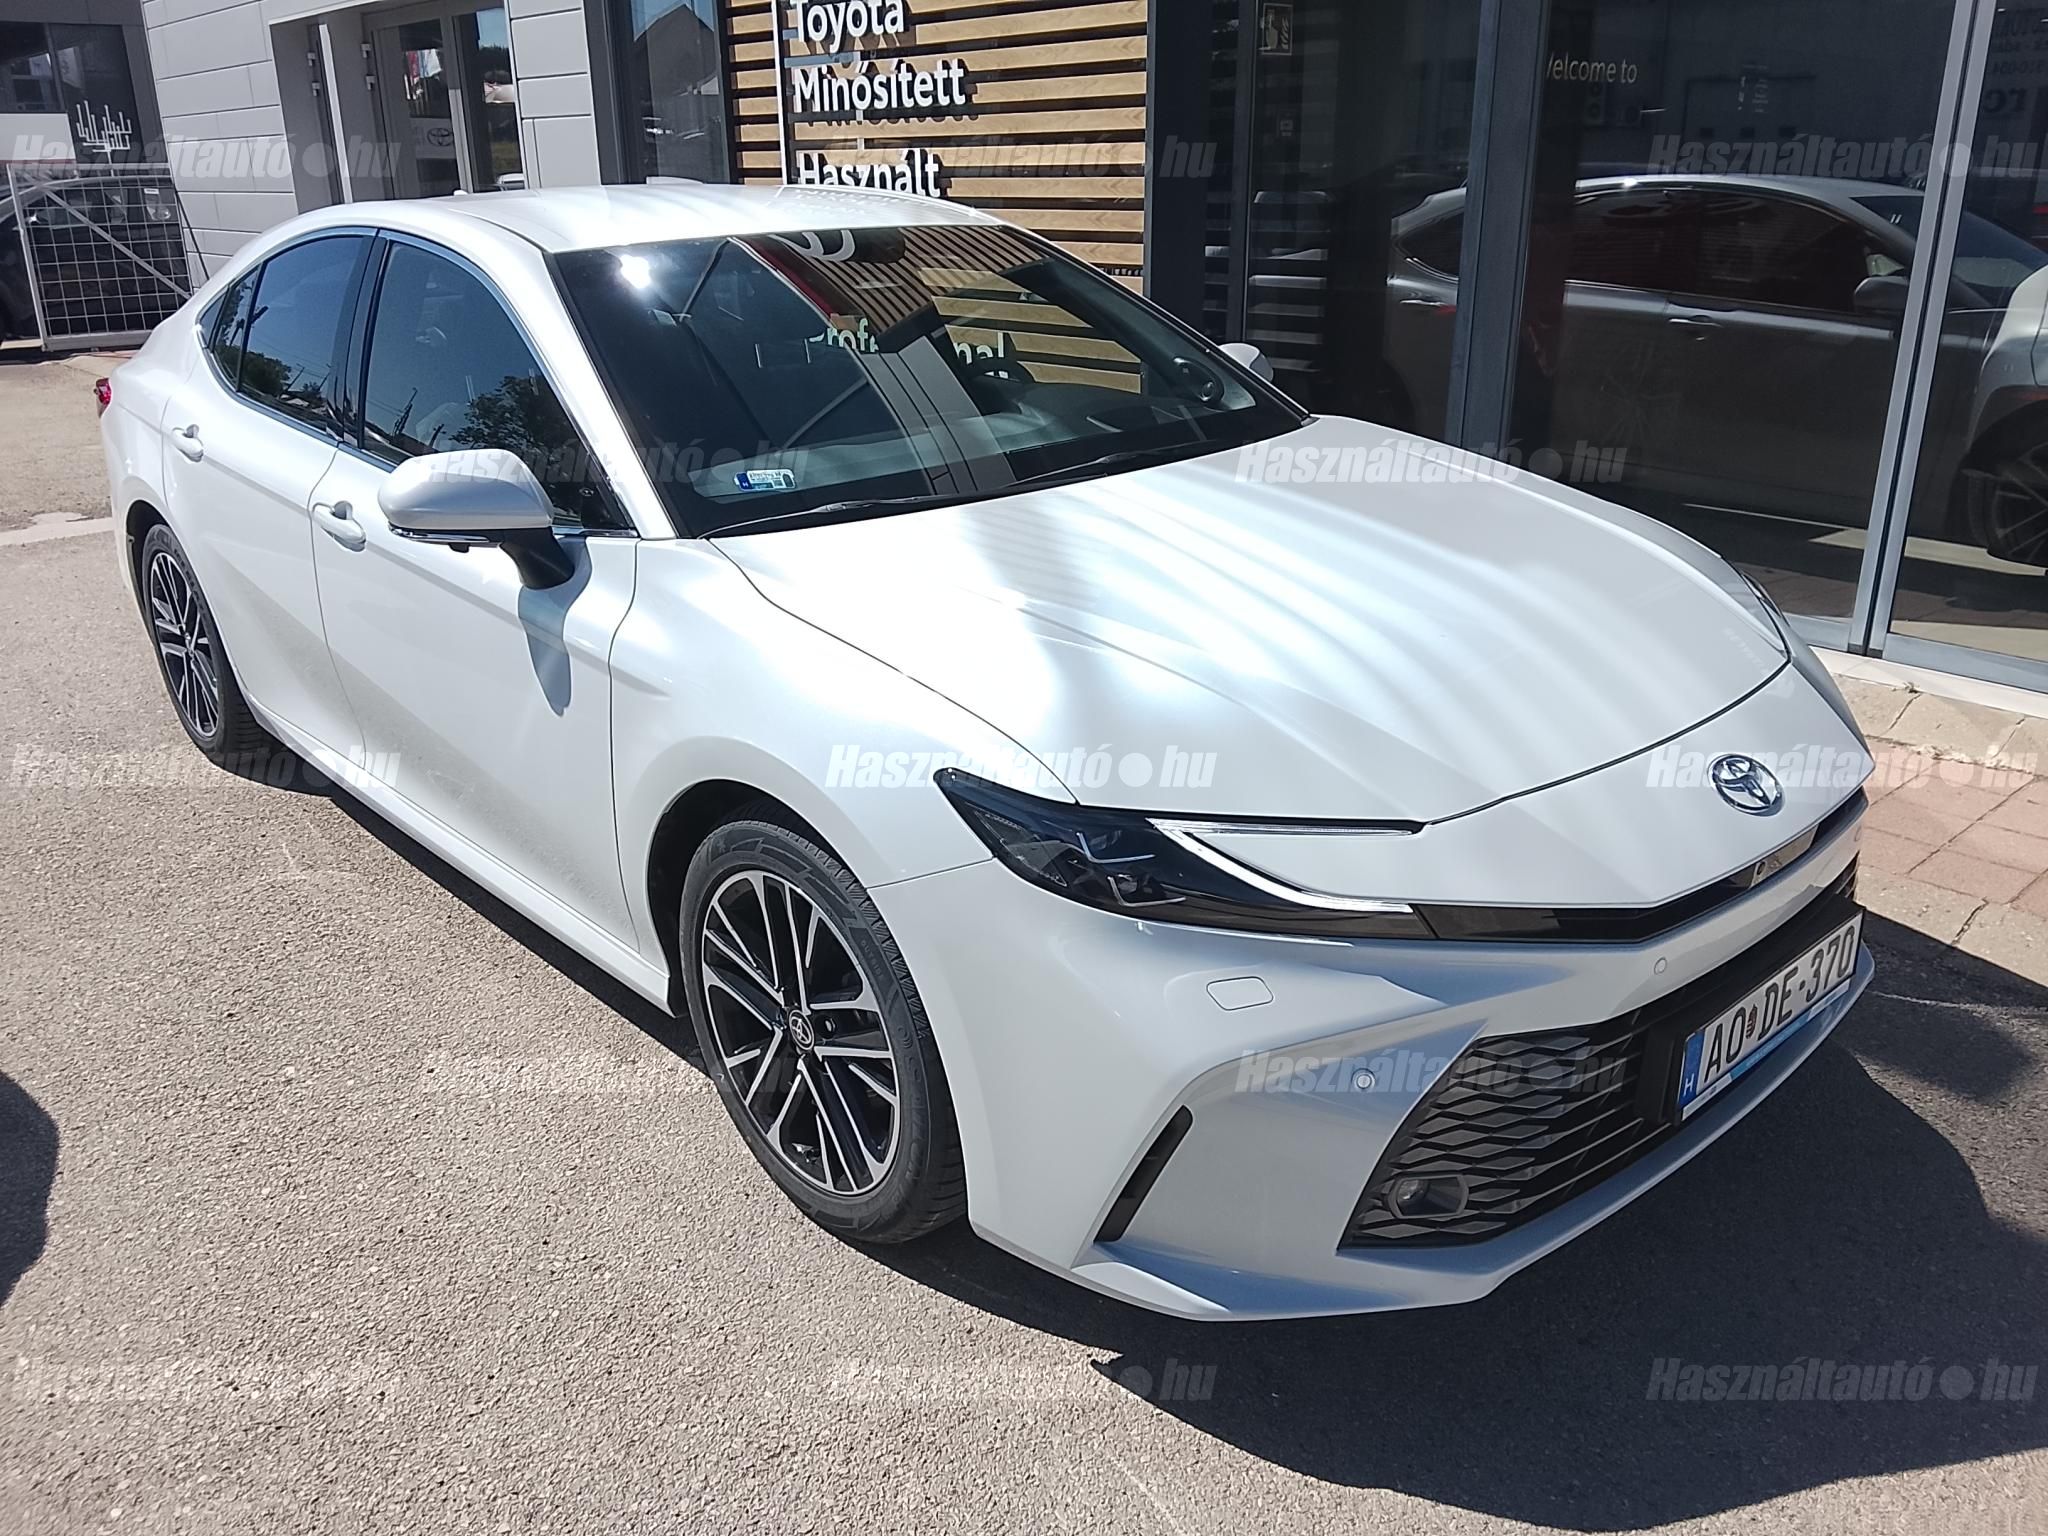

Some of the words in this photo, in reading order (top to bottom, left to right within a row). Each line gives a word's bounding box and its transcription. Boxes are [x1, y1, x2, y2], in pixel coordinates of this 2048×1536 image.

[790, 0, 905, 52] Toyota
[793, 58, 966, 113] Minősített
[1621, 59, 1638, 83] to
[798, 148, 941, 198] Használt
[1703, 1006, 1747, 1084] AO
[1683, 1073, 1698, 1097] H
